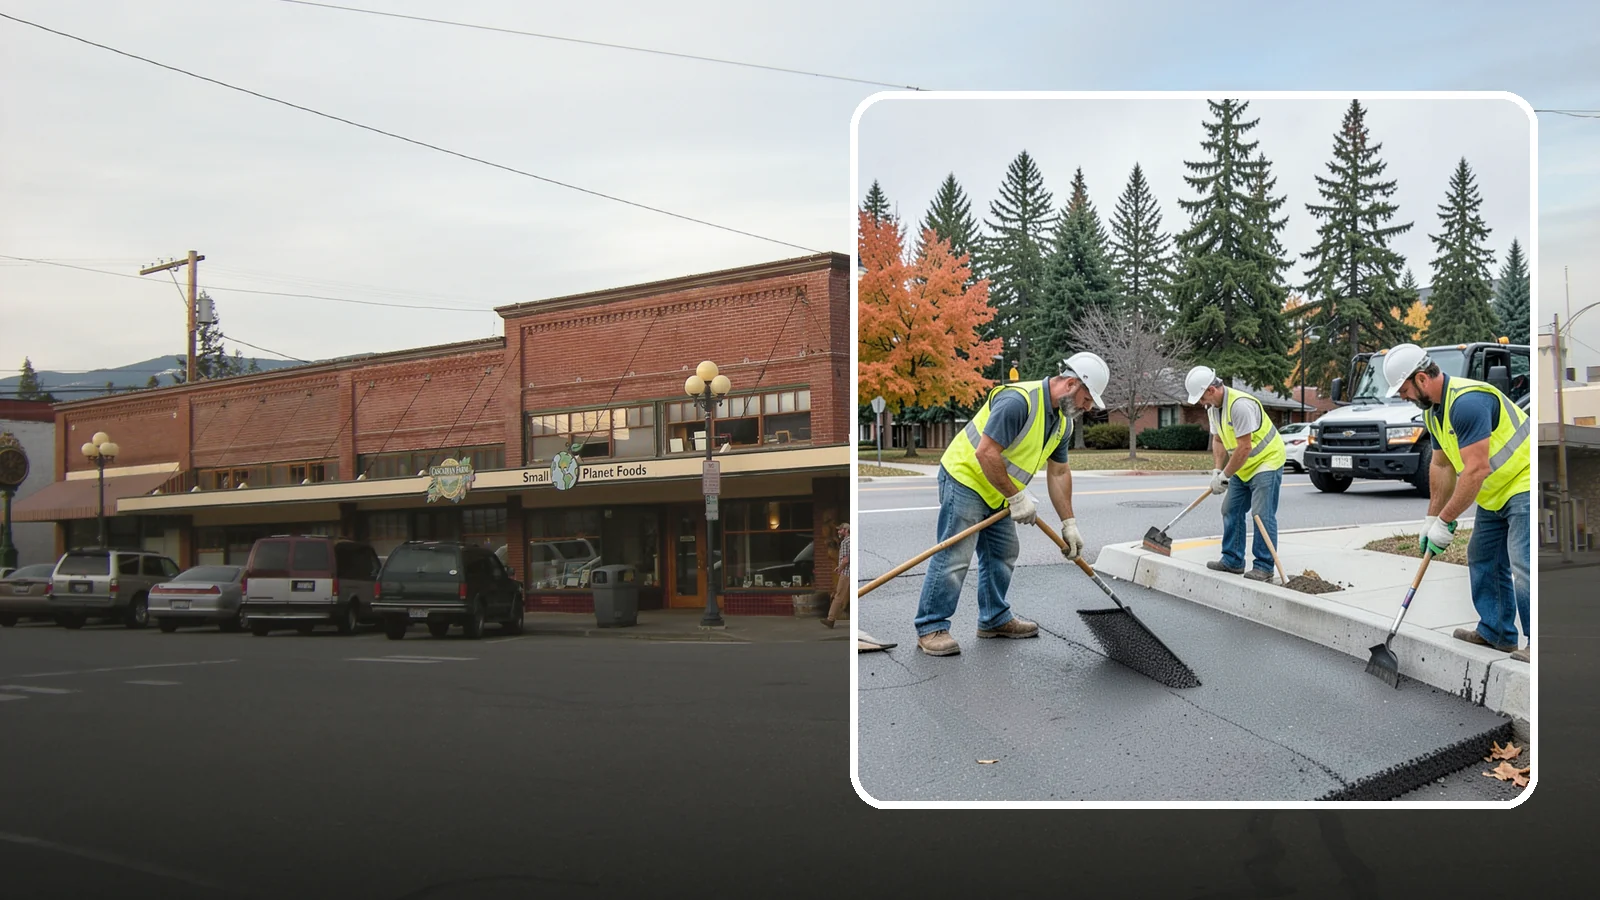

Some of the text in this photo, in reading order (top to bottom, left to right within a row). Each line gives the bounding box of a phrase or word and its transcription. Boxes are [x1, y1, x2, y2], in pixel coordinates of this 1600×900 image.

[523, 464, 647, 483] Small Planet Foods
